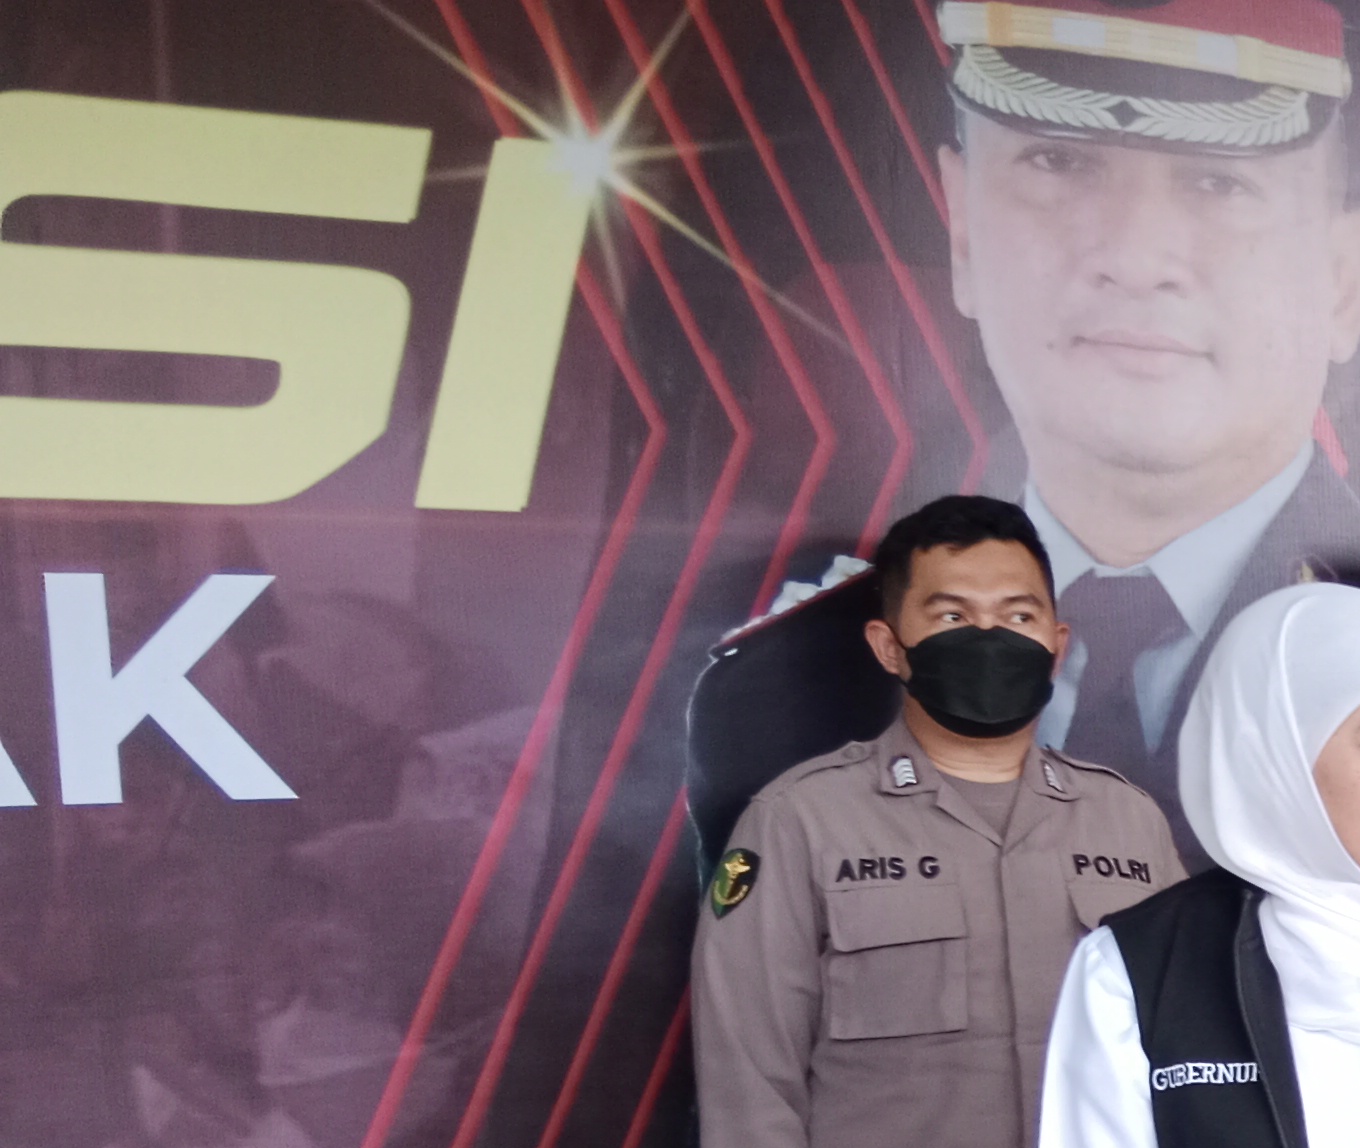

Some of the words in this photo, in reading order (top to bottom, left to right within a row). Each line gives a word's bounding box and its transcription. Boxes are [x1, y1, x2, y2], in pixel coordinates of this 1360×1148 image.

[0, 572, 299, 806] K
[836, 857, 906, 883] ARIS
[918, 855, 941, 880] G
[1072, 854, 1152, 885] POLRI
